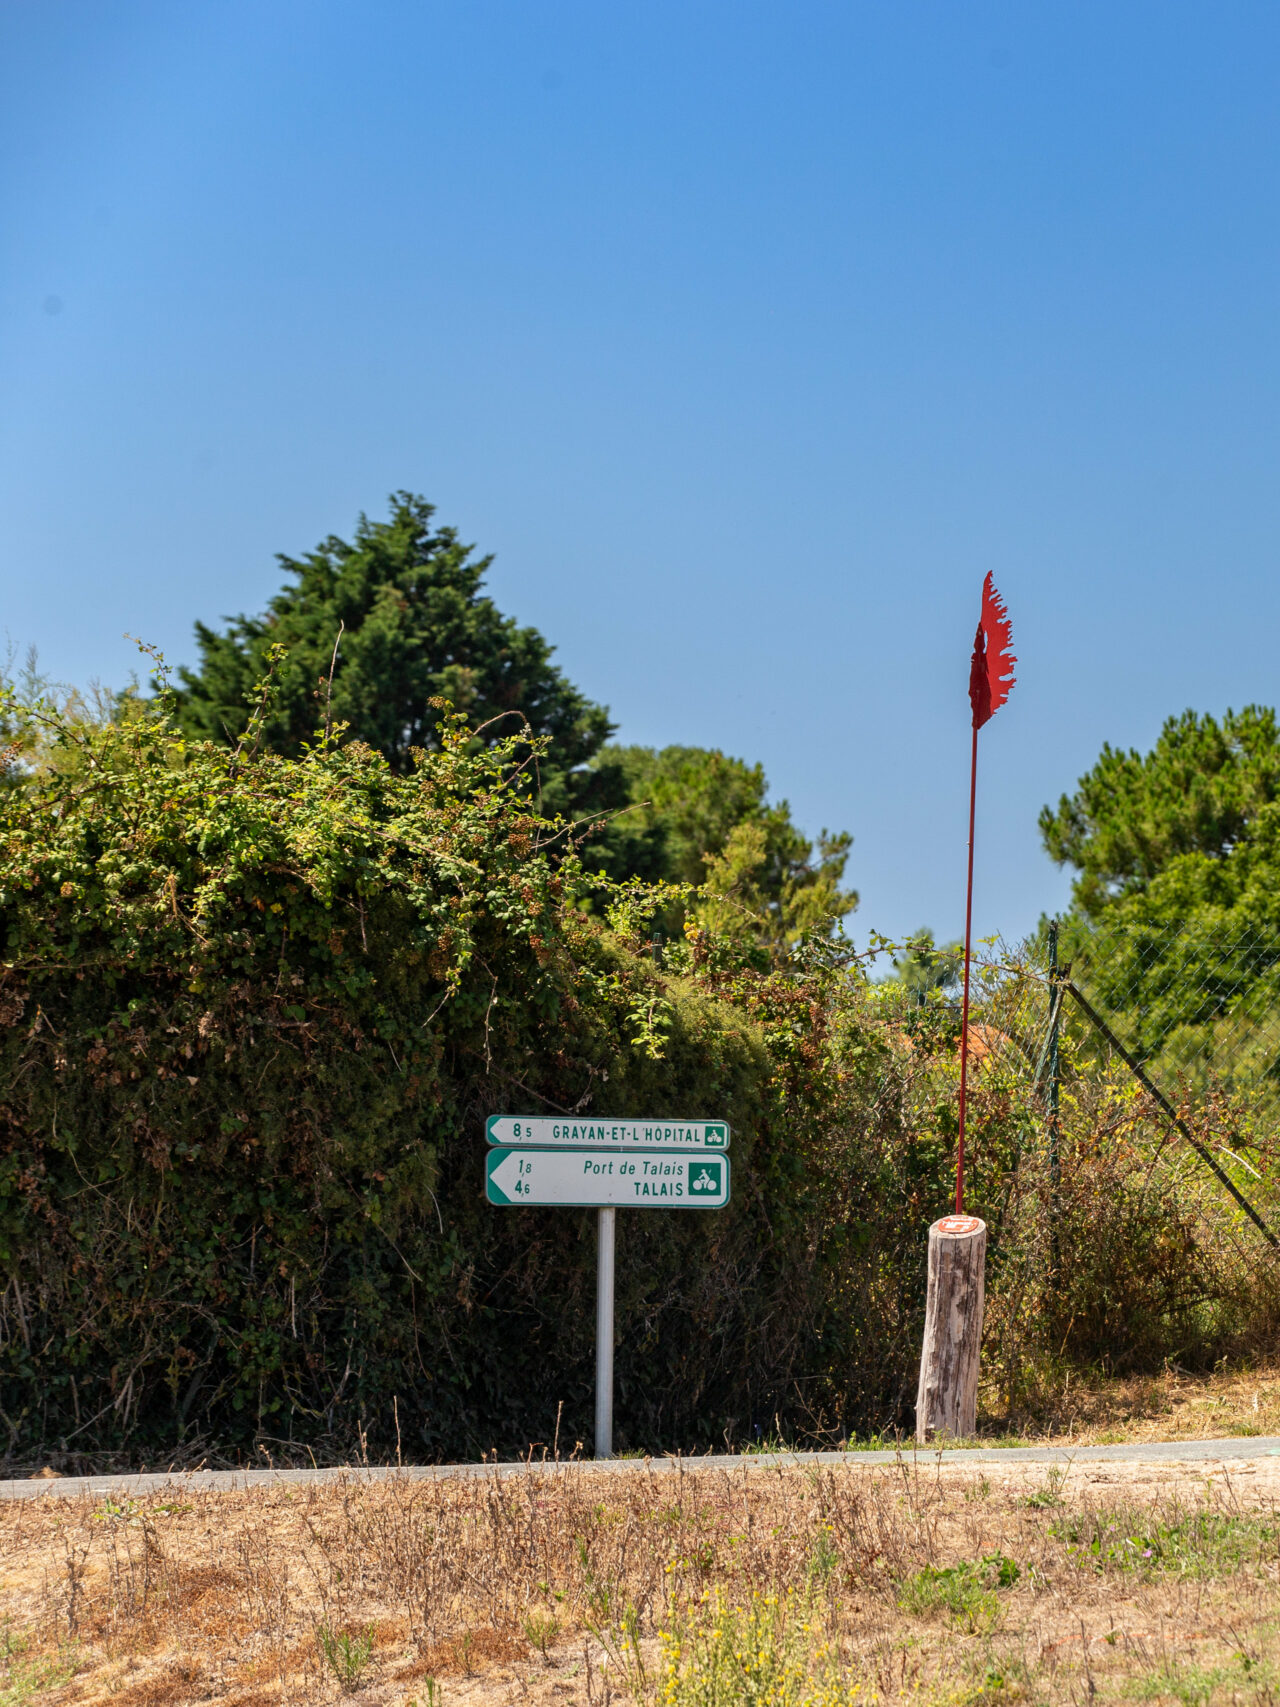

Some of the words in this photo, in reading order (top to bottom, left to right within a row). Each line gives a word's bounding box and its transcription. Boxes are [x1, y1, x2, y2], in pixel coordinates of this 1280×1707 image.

[583, 1160, 613, 1175] Port
[619, 1161, 636, 1175] de
[642, 1161, 684, 1176] Talais
[634, 1182, 683, 1196] TALAIS
